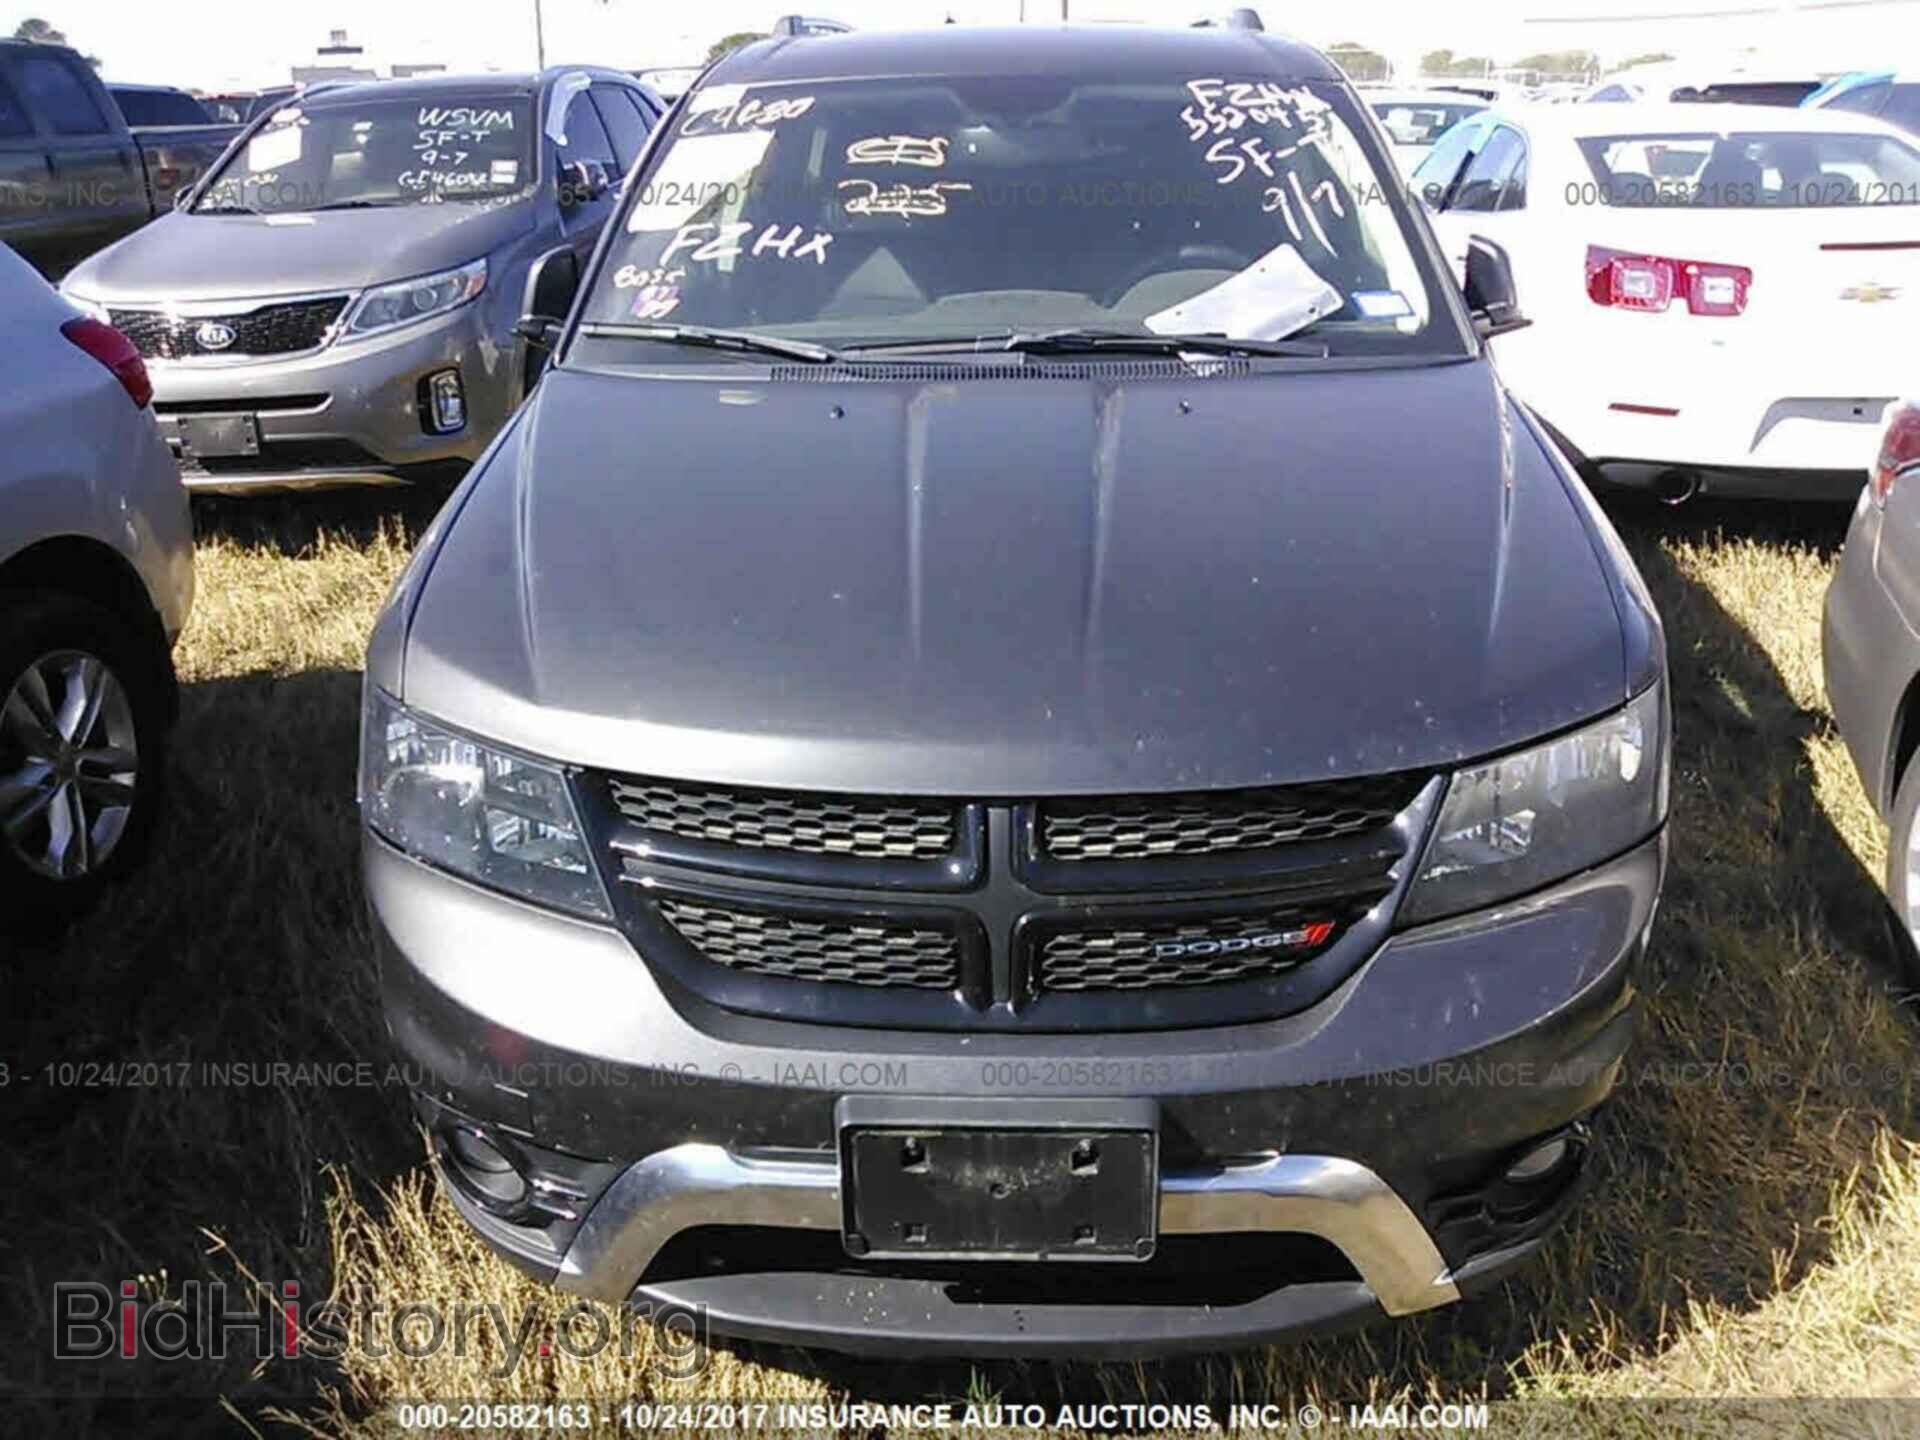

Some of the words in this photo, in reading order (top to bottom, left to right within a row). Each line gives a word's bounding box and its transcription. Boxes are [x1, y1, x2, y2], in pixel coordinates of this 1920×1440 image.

[418, 107, 513, 129] WSVM
[413, 129, 490, 150] SF-T
[421, 149, 468, 165] 9-7
[1155, 930, 1308, 957] DODGE
